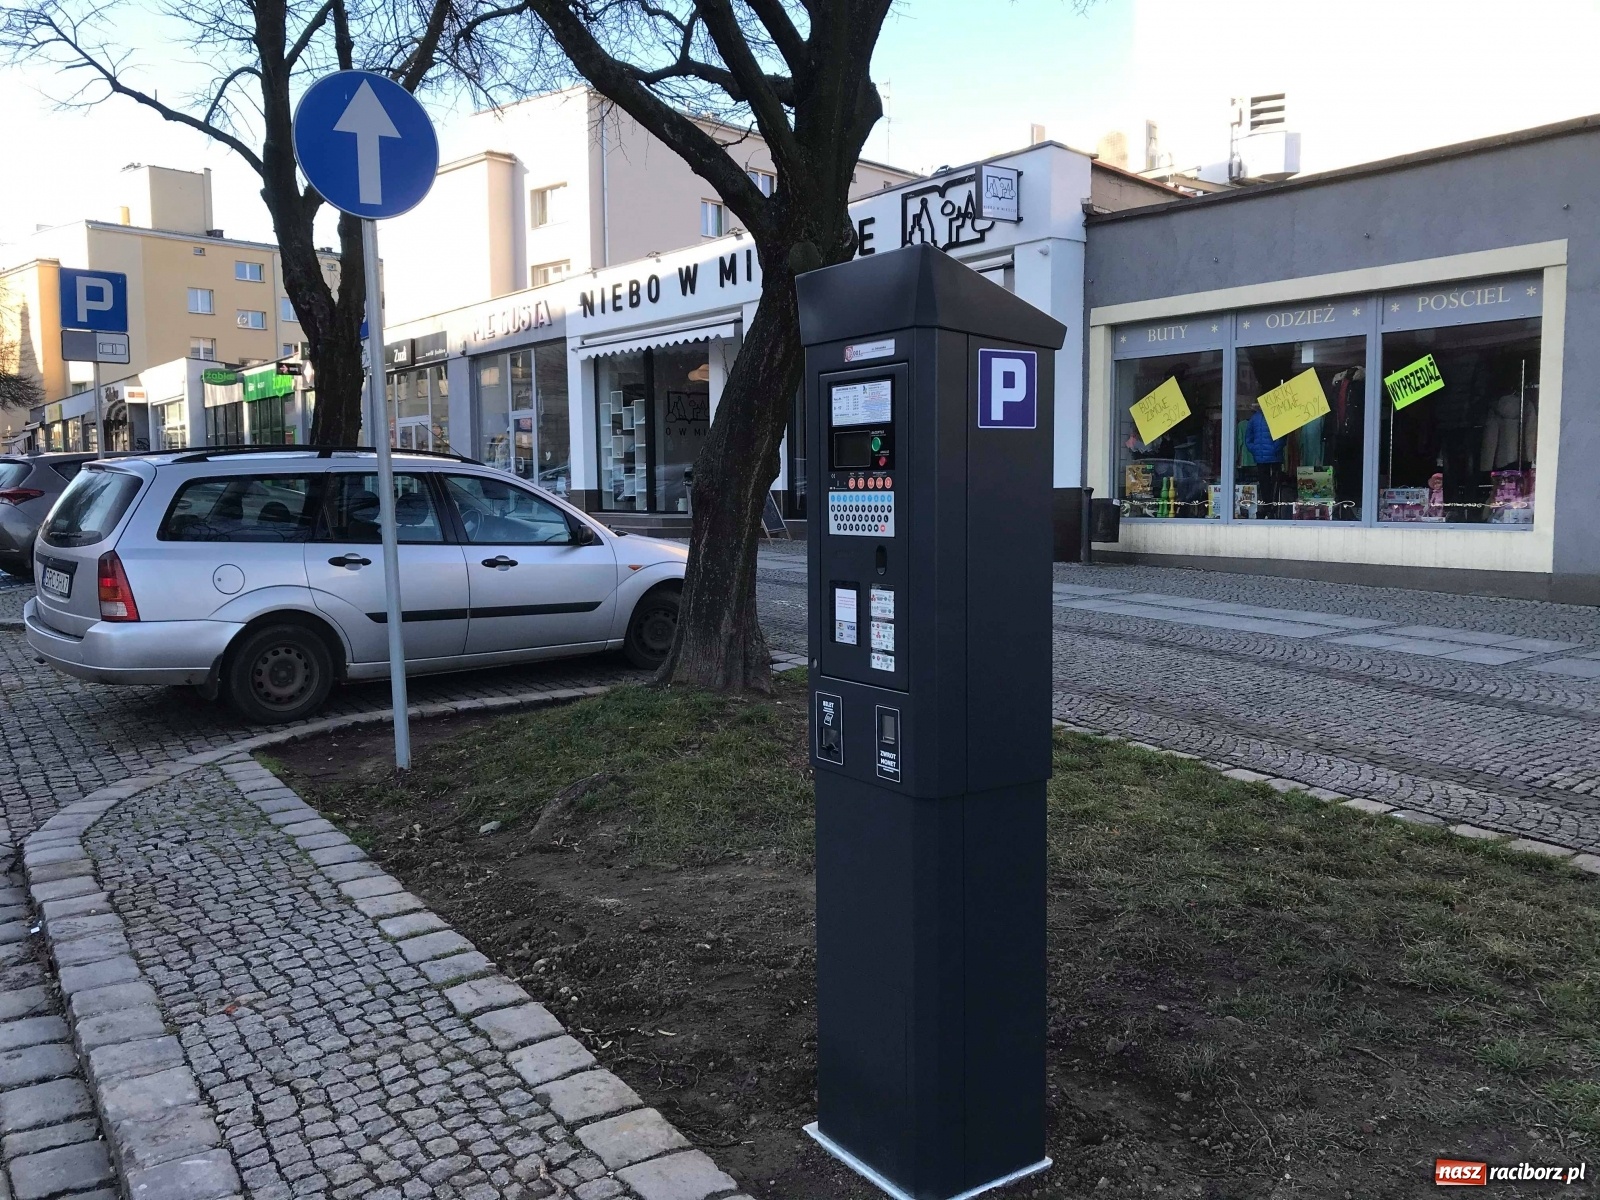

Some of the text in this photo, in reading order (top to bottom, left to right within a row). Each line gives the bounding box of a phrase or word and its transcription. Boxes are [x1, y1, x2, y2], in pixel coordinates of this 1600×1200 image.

[76, 276, 114, 322] P
[580, 274, 661, 318] NIEBO
[678, 263, 699, 296] W
[1417, 286, 1511, 313] POŚCIEL
[1265, 303, 1336, 329] ODZIEŻ
[1147, 325, 1188, 343] BUTY
[991, 357, 1027, 421] P
[1387, 356, 1441, 403] WYPRZEDAŻ
[1138, 392, 1156, 414] BUTY
[1263, 384, 1294, 408] KURTKI
[1161, 402, 1186, 428] -30%
[880, 750, 897, 760] ZWROT
[880, 758, 897, 768] MONET
